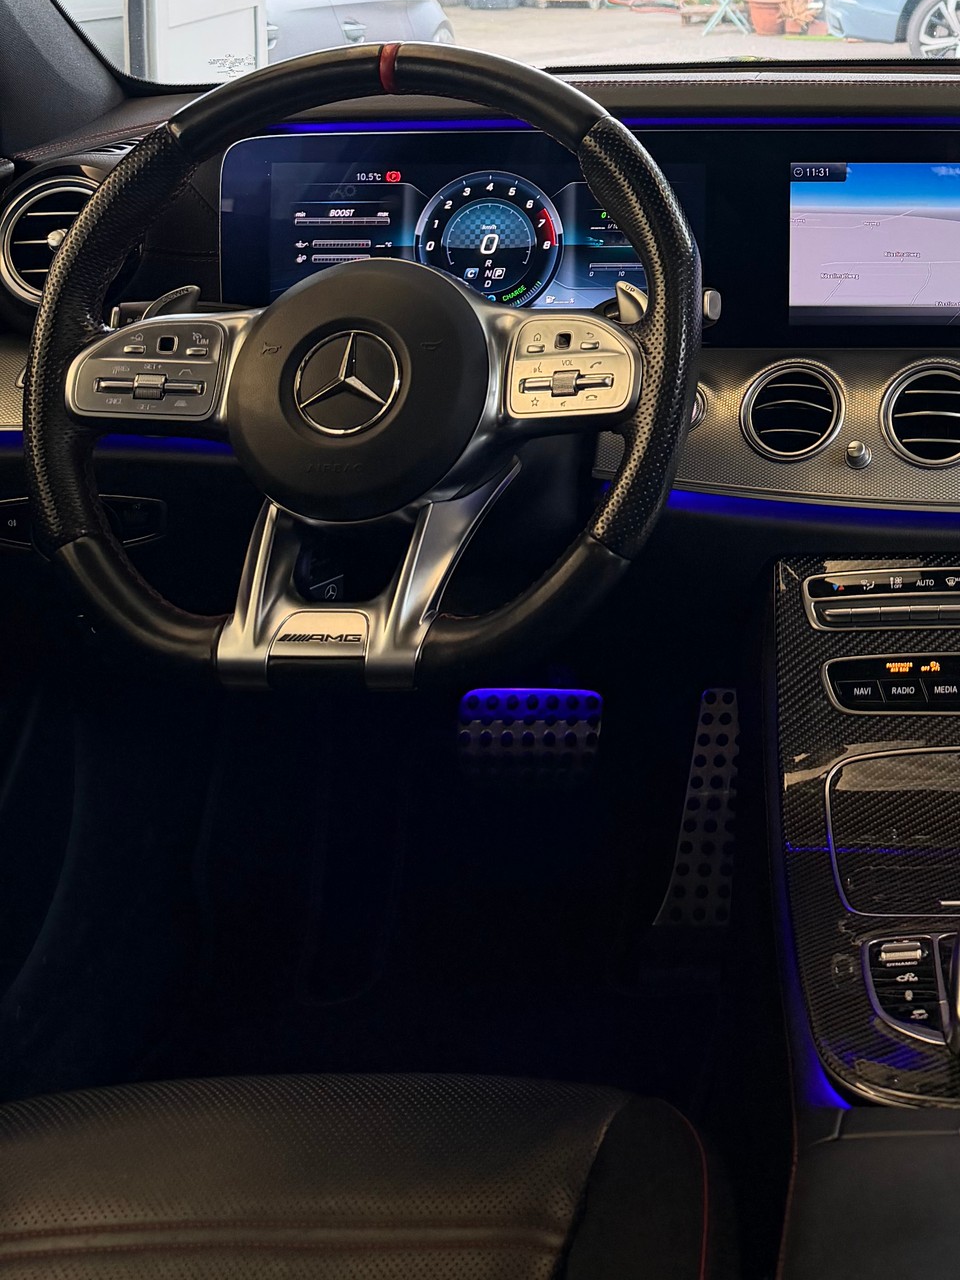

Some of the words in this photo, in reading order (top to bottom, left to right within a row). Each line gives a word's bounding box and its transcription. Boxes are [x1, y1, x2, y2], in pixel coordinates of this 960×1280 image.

[806, 167, 829, 177] 11:31
[356, 173, 382, 181] 10.5°C
[329, 209, 355, 218] BOOST
[425, 241, 435, 252] 0
[433, 219, 439, 229] 1
[444, 200, 453, 210] 2
[462, 187, 471, 197] 3
[485, 182, 494, 192] 4
[508, 187, 517, 197] 5
[526, 199, 534, 209] 6
[538, 219, 546, 228] 7
[542, 240, 552, 250] 8
[480, 233, 499, 255] 0
[484, 259, 493, 268] R
[484, 280, 492, 288] D
[624, 284, 636, 293] UP
[502, 284, 527, 302] CHARGE
[916, 579, 934, 587] AUTO
[309, 633, 362, 643] AMG
[853, 687, 872, 695] NAVI
[891, 686, 915, 694] RADIO
[934, 685, 958, 693] MEDIA
